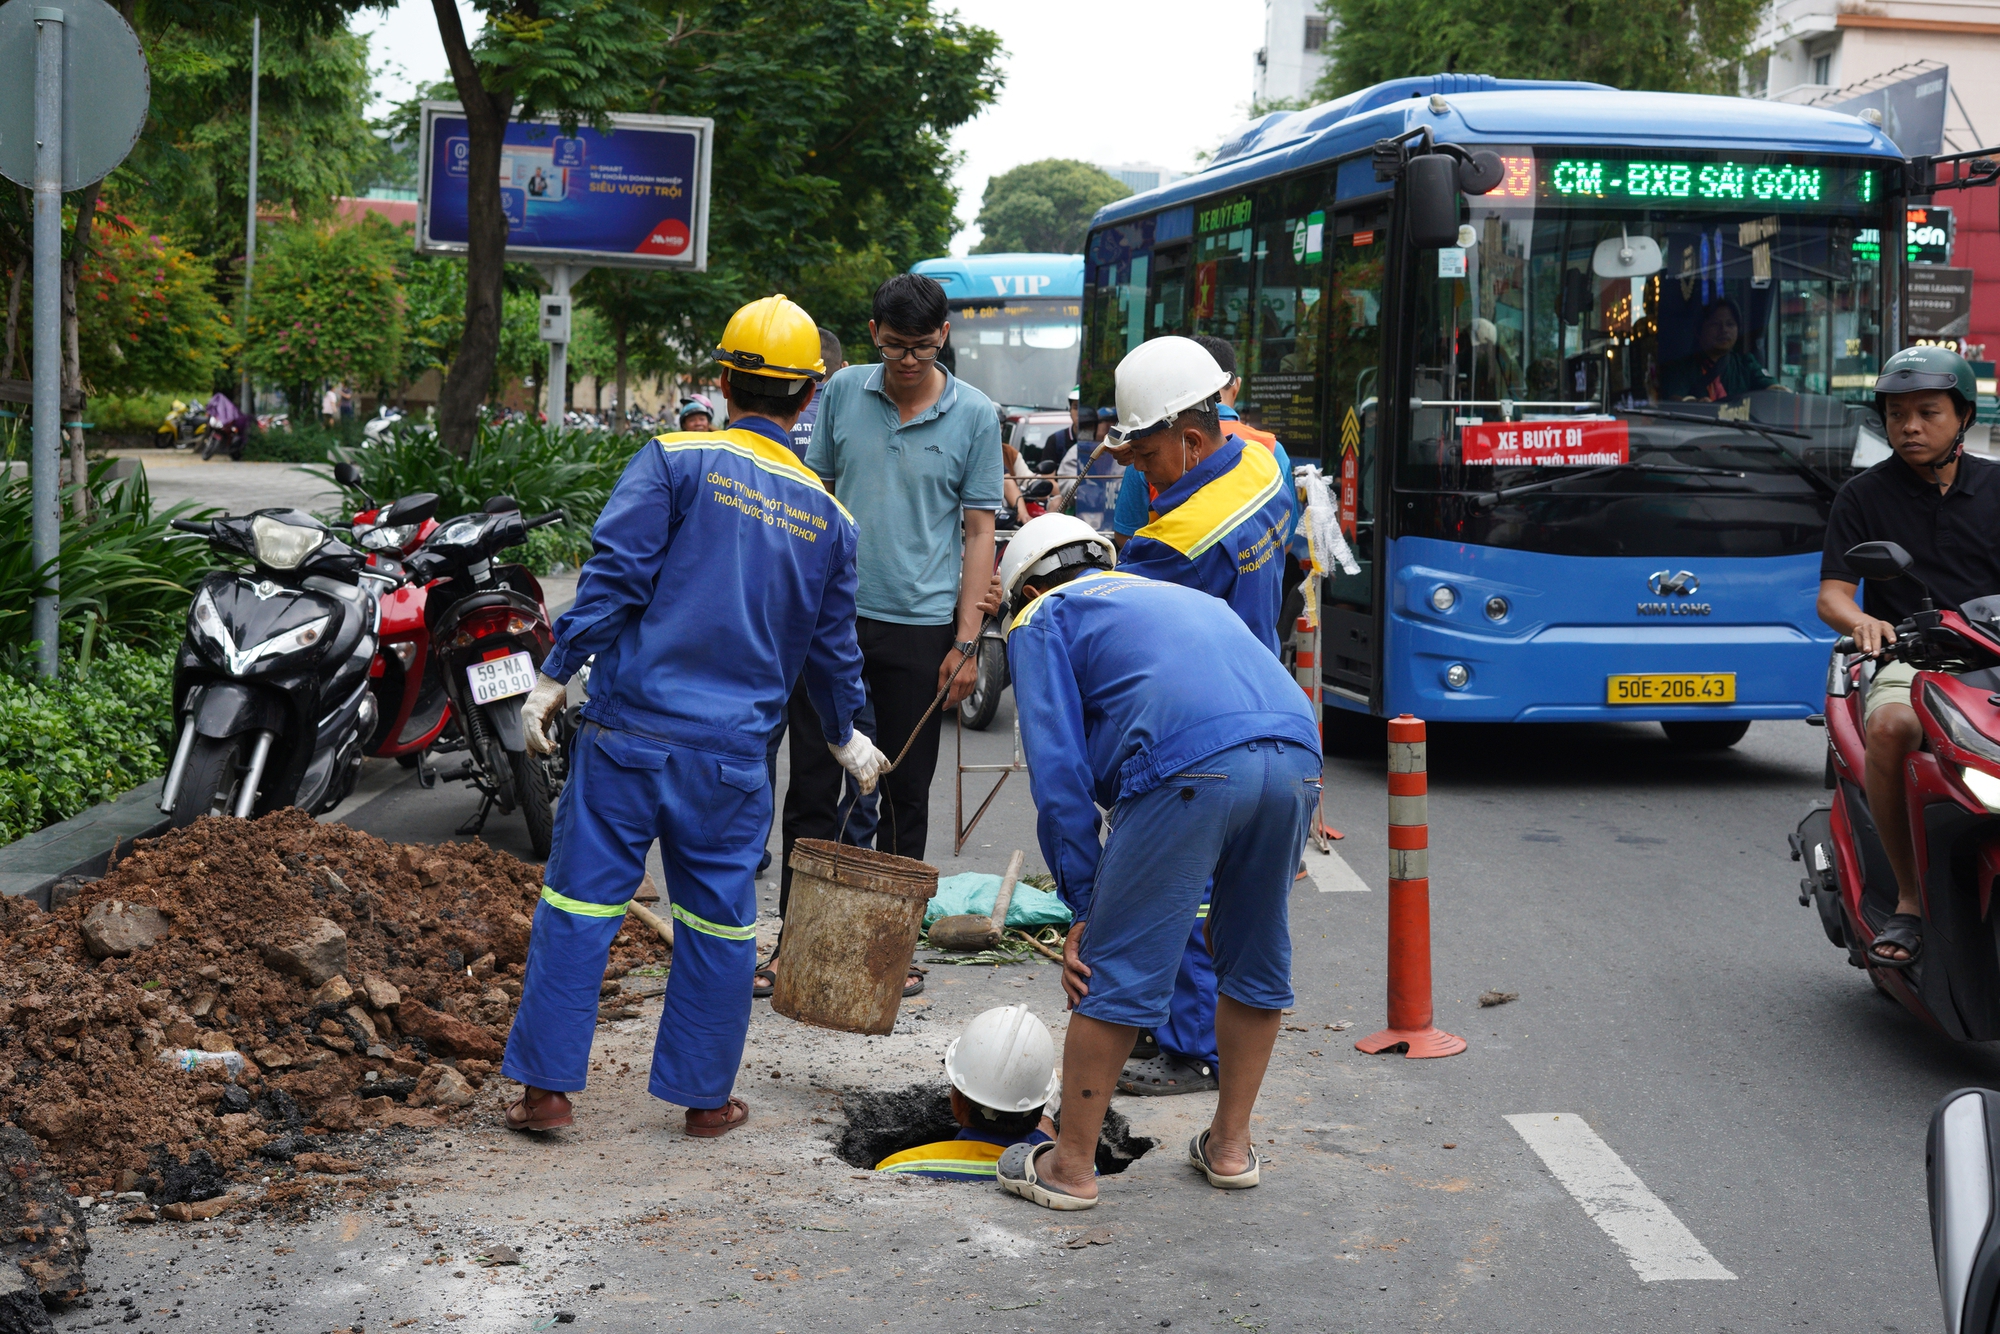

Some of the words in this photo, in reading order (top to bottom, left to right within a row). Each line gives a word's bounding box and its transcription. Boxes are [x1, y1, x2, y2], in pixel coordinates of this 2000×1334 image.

[454, 143, 469, 159] 0
[589, 180, 616, 193] SIÊU
[618, 184, 651, 197] VƯỢT
[654, 185, 683, 199] TRỘI
[1554, 161, 1602, 194] CM
[1628, 163, 1691, 197] BXB
[990, 275, 1051, 297] VIP
[794, 435, 811, 445] THOÁ
[1498, 431, 1518, 450] XE
[1523, 426, 1562, 449] BUÝT
[1566, 428, 1582, 447] ĐI
[706, 471, 733, 489] CÔNG
[733, 480, 744, 493] TY
[811, 514, 828, 531] VIÊN
[713, 490, 742, 509] THOÁT
[776, 517, 788, 530] TH
[788, 522, 817, 544] TP.HCM
[1238, 548, 1251, 561] NG
[1637, 602, 1667, 617] KIM
[1670, 602, 1711, 616] LONG
[477, 658, 523, 682] 59-NA
[478, 673, 531, 700] 089.90
[1618, 679, 1725, 698] 50E-206.43
